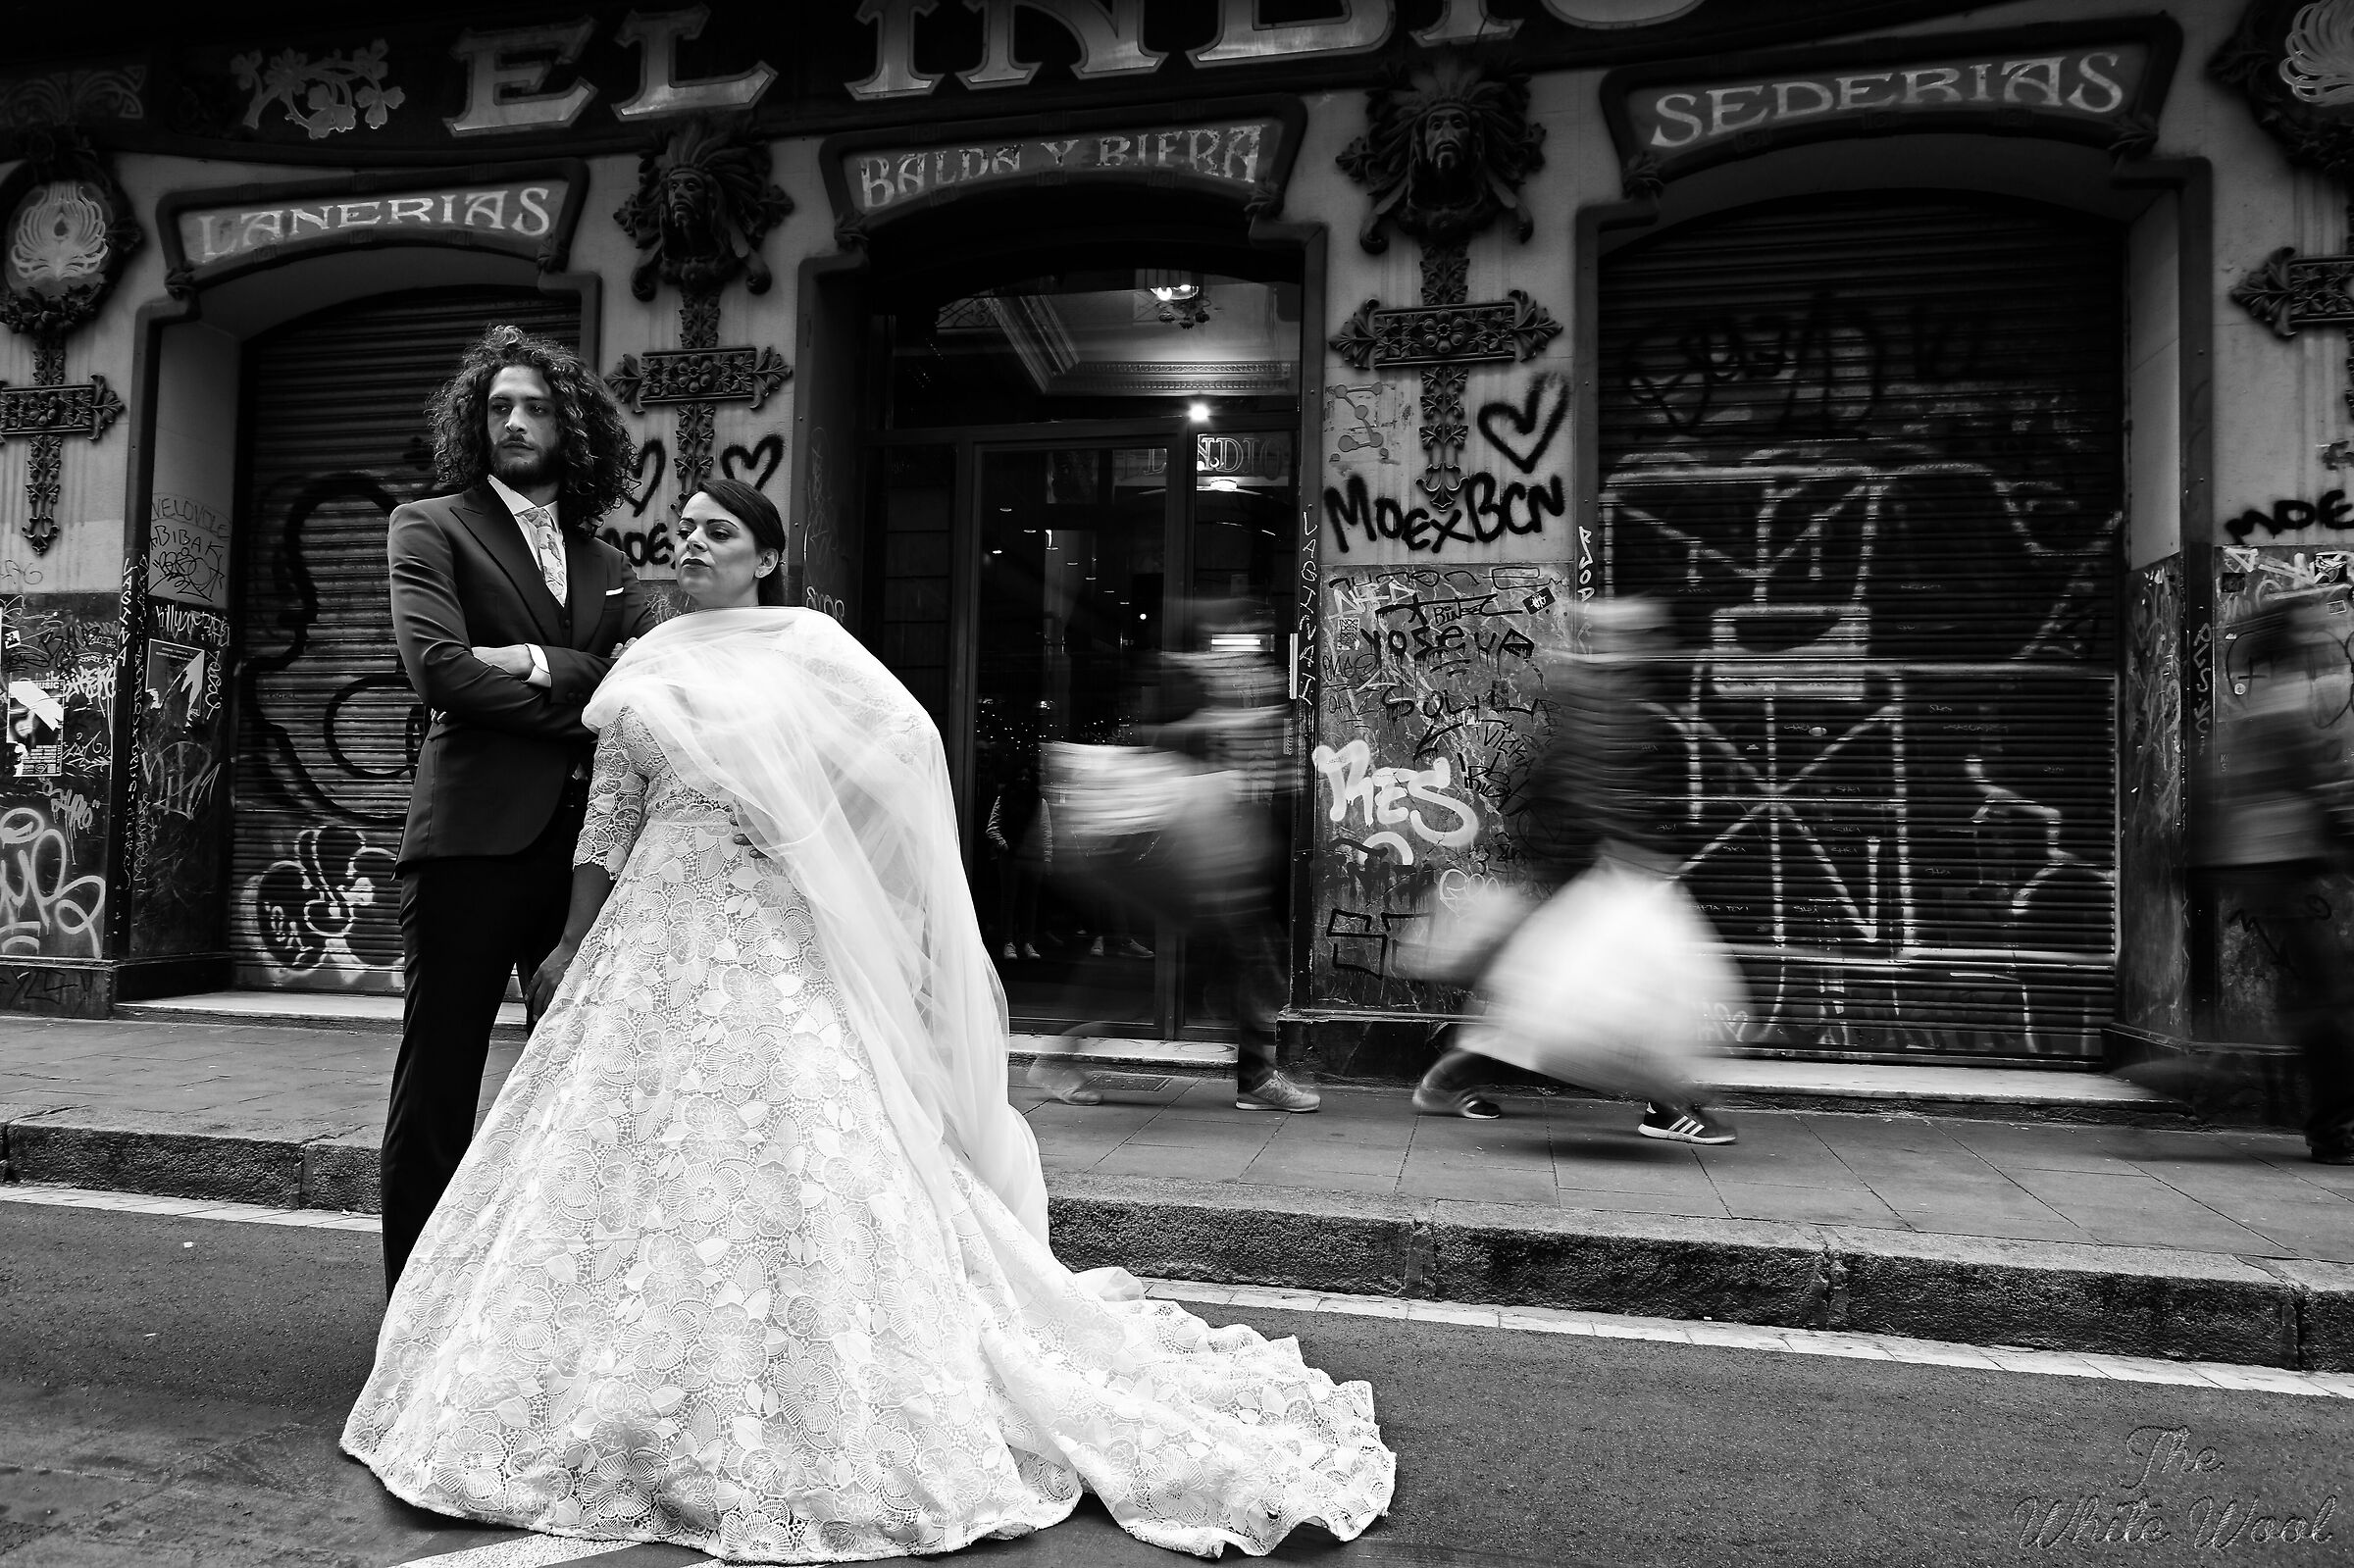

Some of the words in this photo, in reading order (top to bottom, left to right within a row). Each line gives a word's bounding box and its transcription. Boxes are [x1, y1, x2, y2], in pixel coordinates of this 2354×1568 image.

[442, 4, 779, 137] EL
[1651, 52, 2124, 148] SEDERIAS
[1041, 139, 1080, 167] Y
[199, 186, 553, 263] LANERIAS
